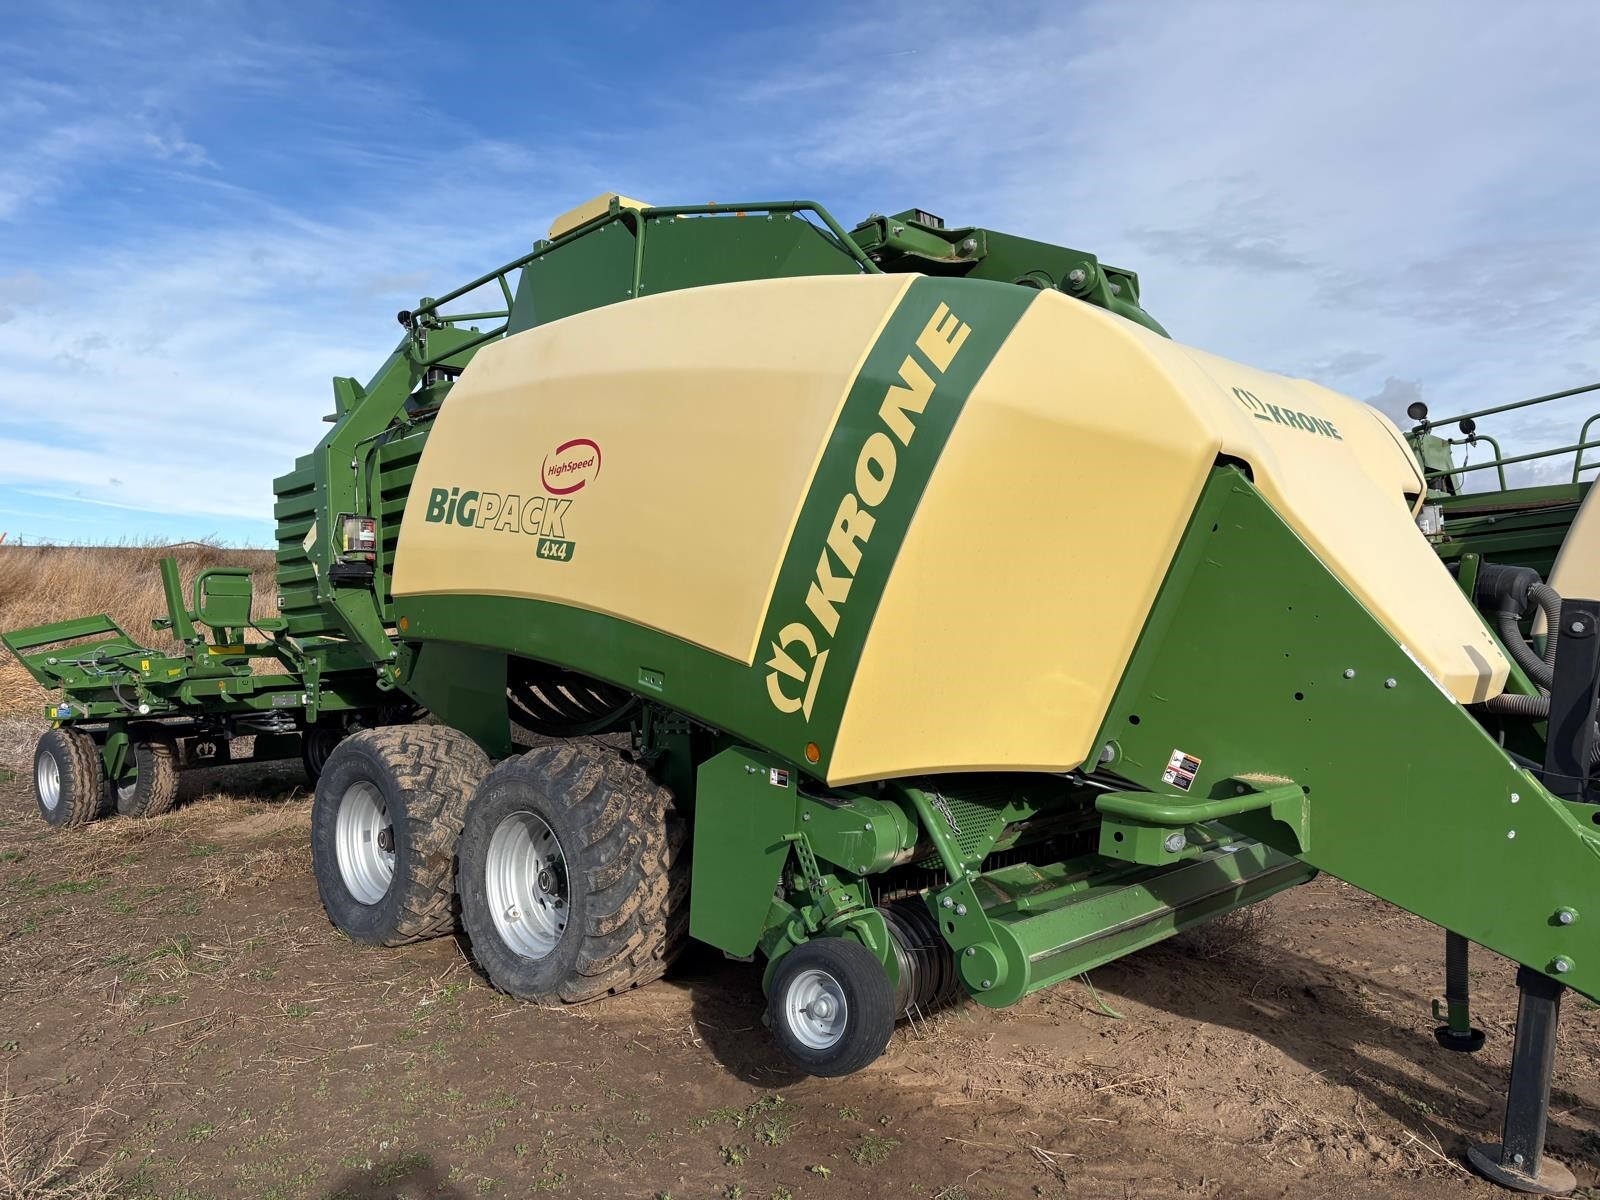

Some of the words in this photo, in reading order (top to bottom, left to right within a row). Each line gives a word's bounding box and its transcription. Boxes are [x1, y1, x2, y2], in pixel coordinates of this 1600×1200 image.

[1266, 403, 1343, 440] KRONE
[548, 456, 595, 477] HighSpeed
[805, 301, 972, 638] KRONE
[540, 540, 567, 560] 4x4
